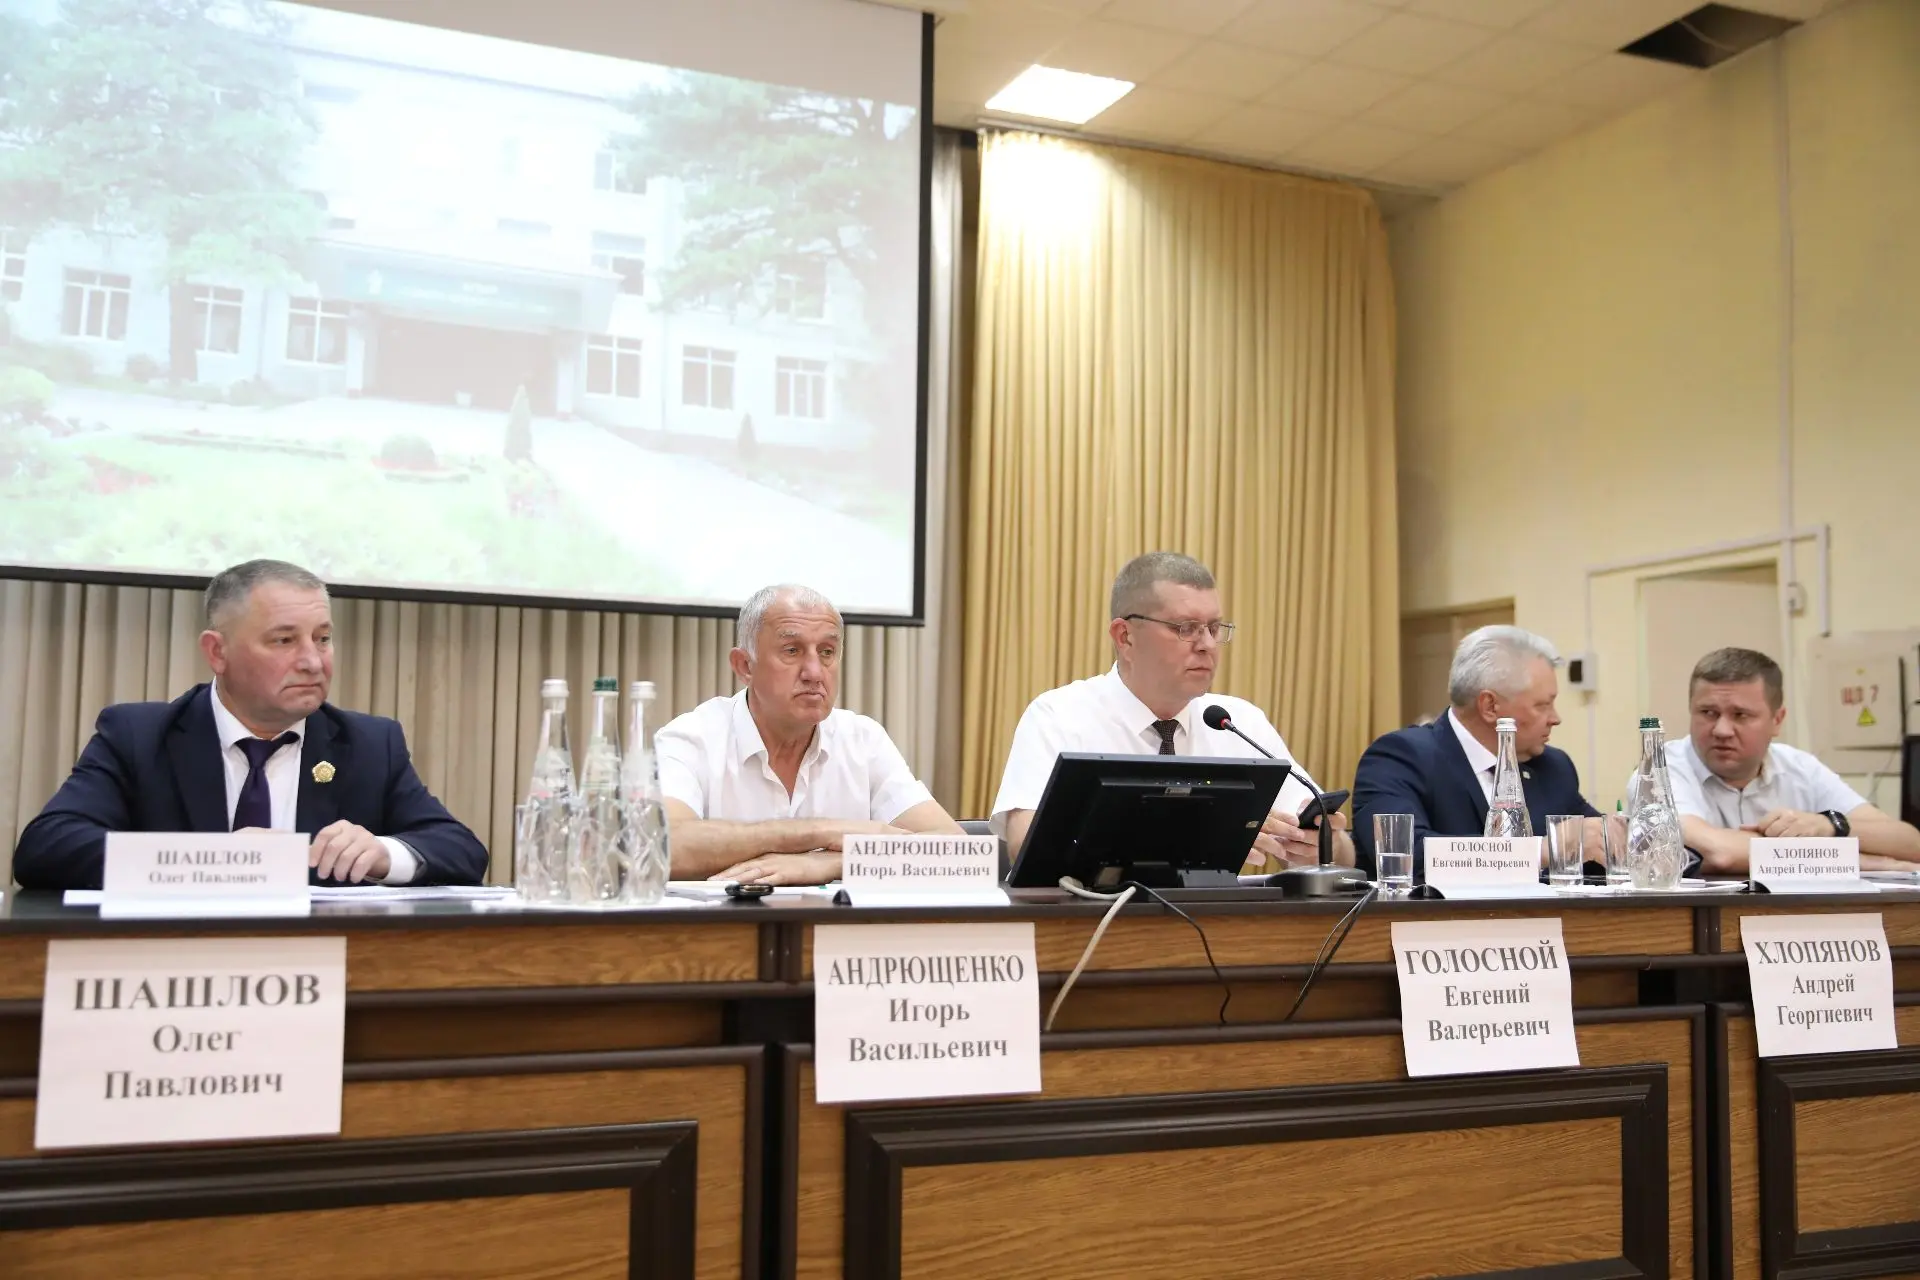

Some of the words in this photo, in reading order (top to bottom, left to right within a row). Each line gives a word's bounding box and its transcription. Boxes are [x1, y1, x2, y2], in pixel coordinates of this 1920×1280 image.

[156, 850, 262, 866] ШАШЛОВ
[850, 840, 993, 858] АНДРЮЩЕНКО
[1450, 839, 1513, 853] ГОЛОСНОЙ
[1772, 847, 1839, 859] ХЛОПЯНОВ
[849, 862, 897, 880] Игорь
[901, 862, 990, 877] Васильевич
[1432, 857, 1473, 868] Евгений
[1475, 857, 1530, 871] Валерьевич
[1758, 863, 1796, 877] Андрей
[1797, 863, 1855, 877] Георгиевич
[1403, 939, 1559, 975] ГОЛОСНОЙ
[1755, 939, 1881, 965] ХЛОПЯНОВ
[828, 954, 1024, 991] АНДРЮЩЕНКО
[74, 974, 321, 1011] ШАШЛОВ
[1444, 982, 1531, 1007] Евгений
[1792, 973, 1855, 999] Андрей
[889, 998, 971, 1029] Игорь
[1776, 1005, 1873, 1030] Георгиевич
[152, 1024, 243, 1053] Олег
[1428, 1019, 1550, 1045] Валерьевич
[849, 1037, 1008, 1062] Васильевич
[104, 1070, 282, 1100] Павлович
